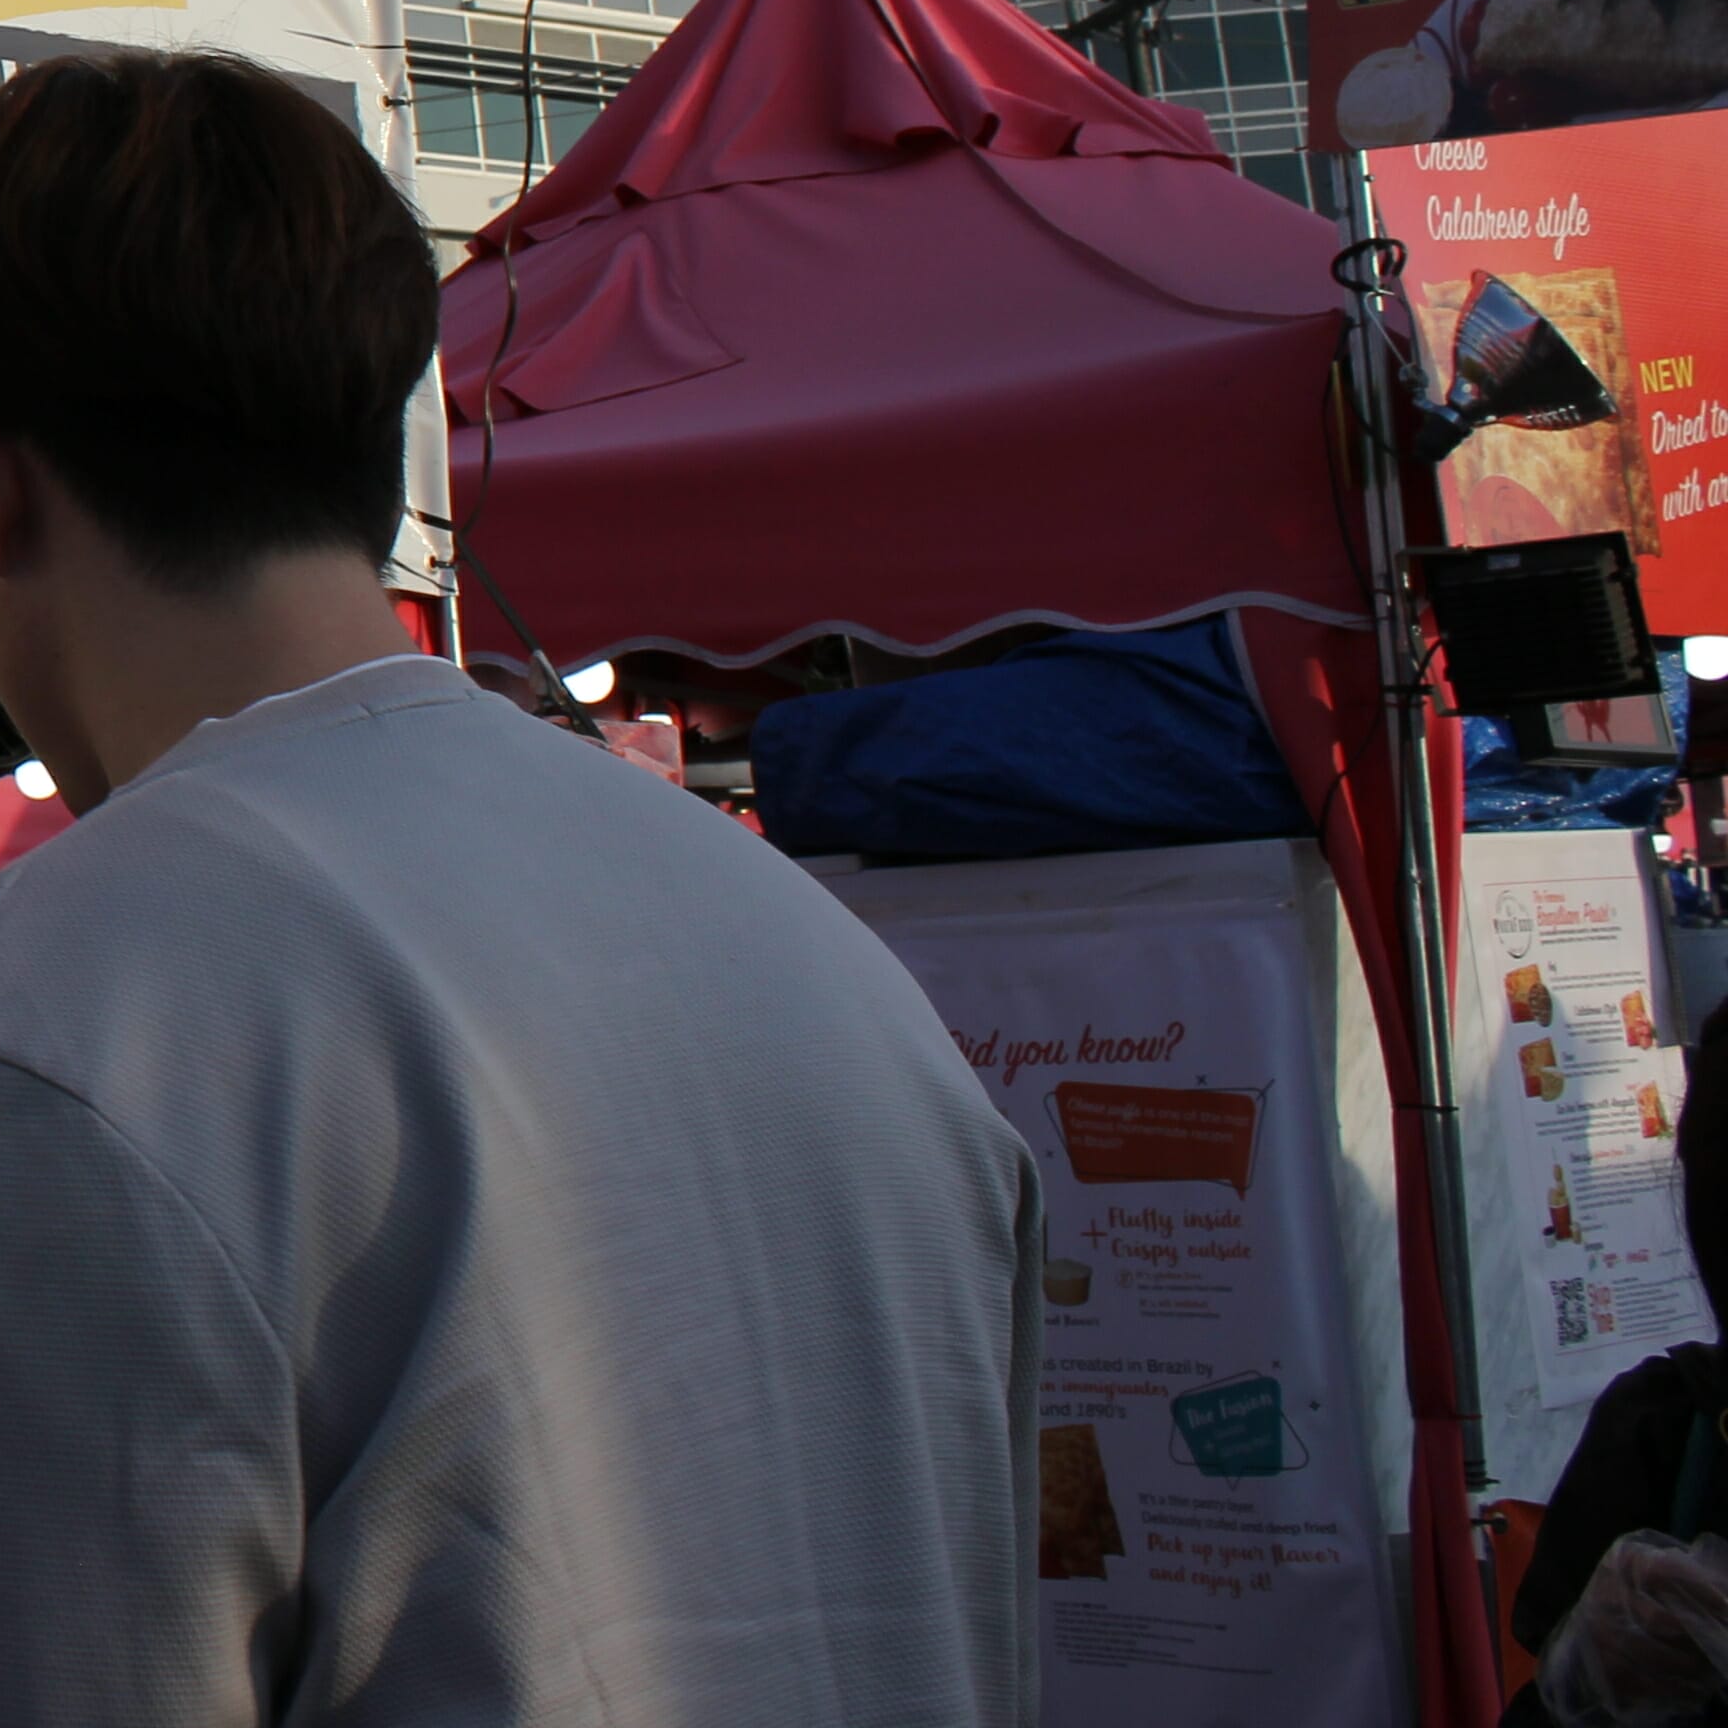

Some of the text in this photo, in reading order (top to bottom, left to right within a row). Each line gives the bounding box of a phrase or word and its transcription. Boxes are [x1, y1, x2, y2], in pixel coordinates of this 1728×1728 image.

[1426, 193, 1591, 261] Calabrese style
[1639, 355, 1694, 394] NEW
[1651, 399, 1708, 455] Dried
[1662, 467, 1704, 522] with
[1003, 1036, 1069, 1087] you
[1076, 1021, 1186, 1065] know?
[1107, 1207, 1242, 1239] Fluffy inside
[1111, 1238, 1253, 1267] Crispy outside
[1060, 1357, 1214, 1378] created in Brazil by
[1076, 1402, 1128, 1419] 1890's
[1265, 1521, 1301, 1537] deep
[1147, 1532, 1342, 1569] Pick up your flavor
[1149, 1565, 1186, 1583] and
[1190, 1570, 1243, 1600] enjoy
